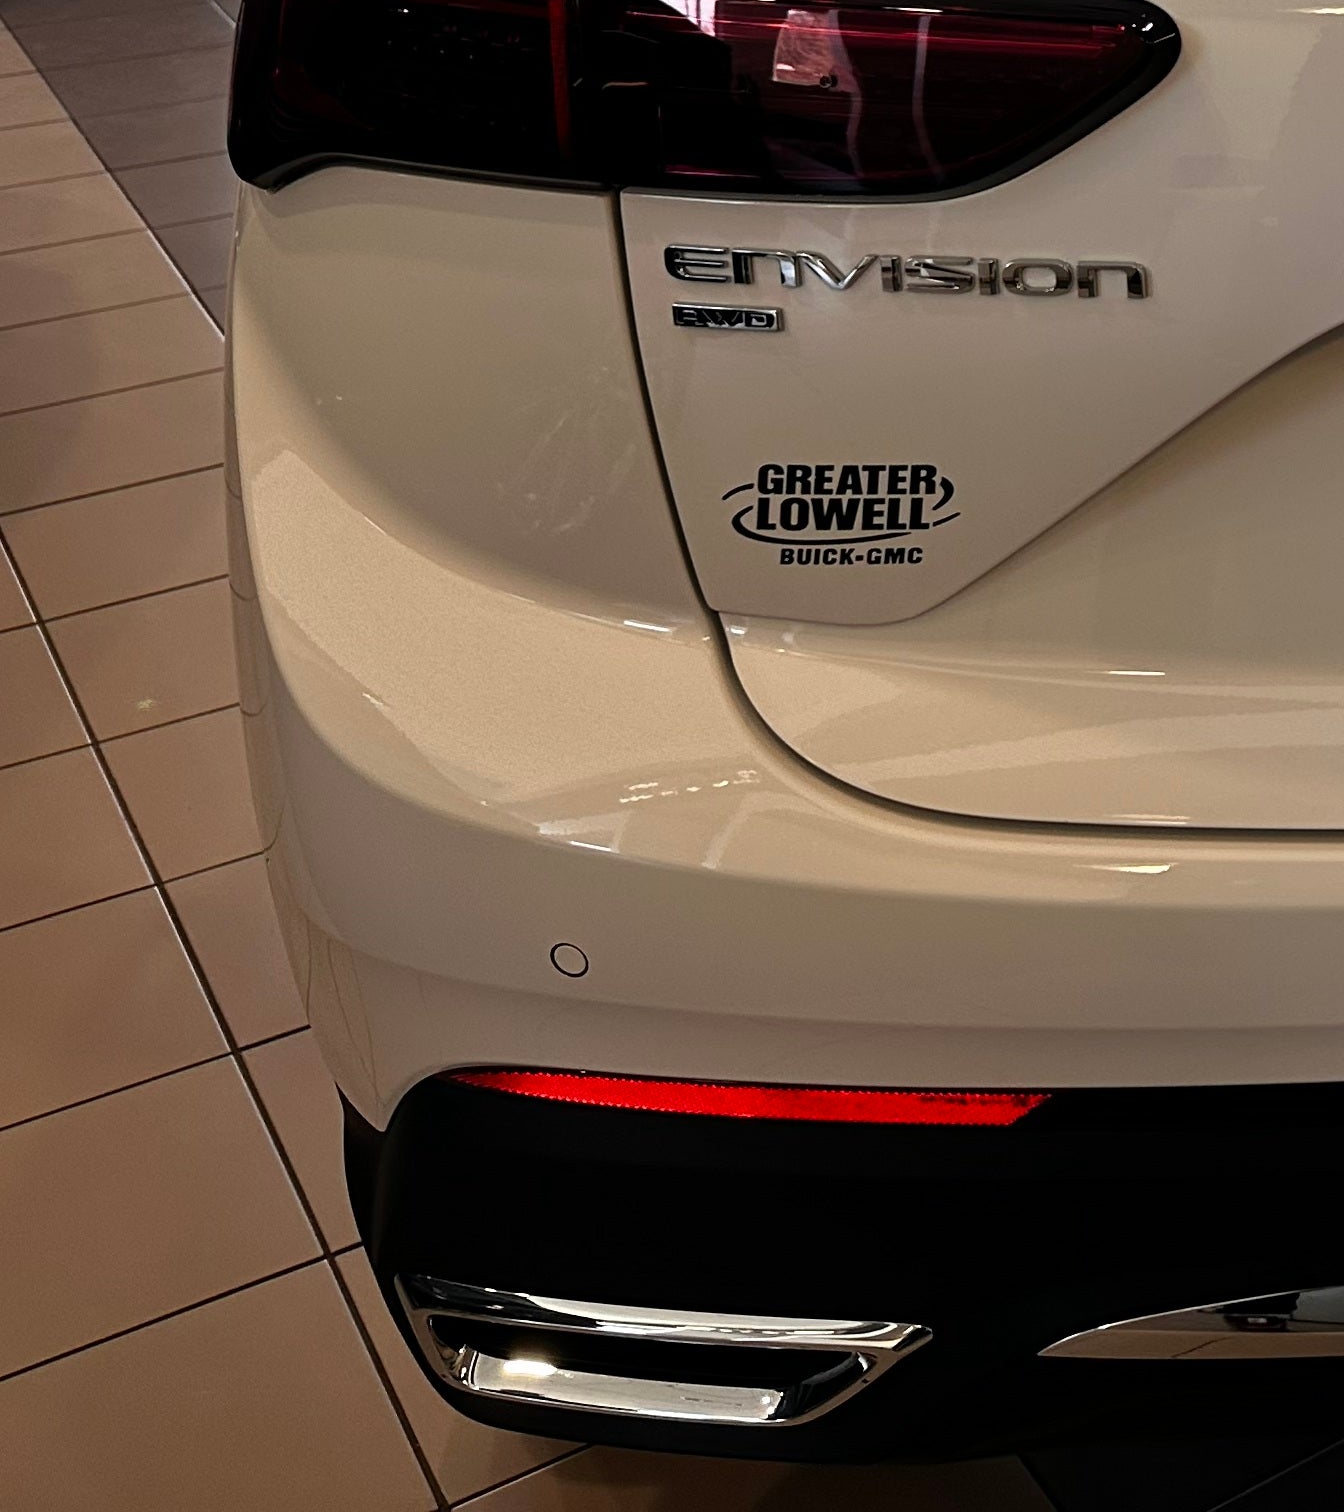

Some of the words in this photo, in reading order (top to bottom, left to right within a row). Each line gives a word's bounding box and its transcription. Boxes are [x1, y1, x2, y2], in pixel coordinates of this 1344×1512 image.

[663, 242, 1150, 300] ENVISION
[674, 306, 777, 331] AWD
[757, 463, 938, 496] GREATER
[756, 496, 931, 531] LOWELL
[779, 546, 924, 566] BUICK-GMC
